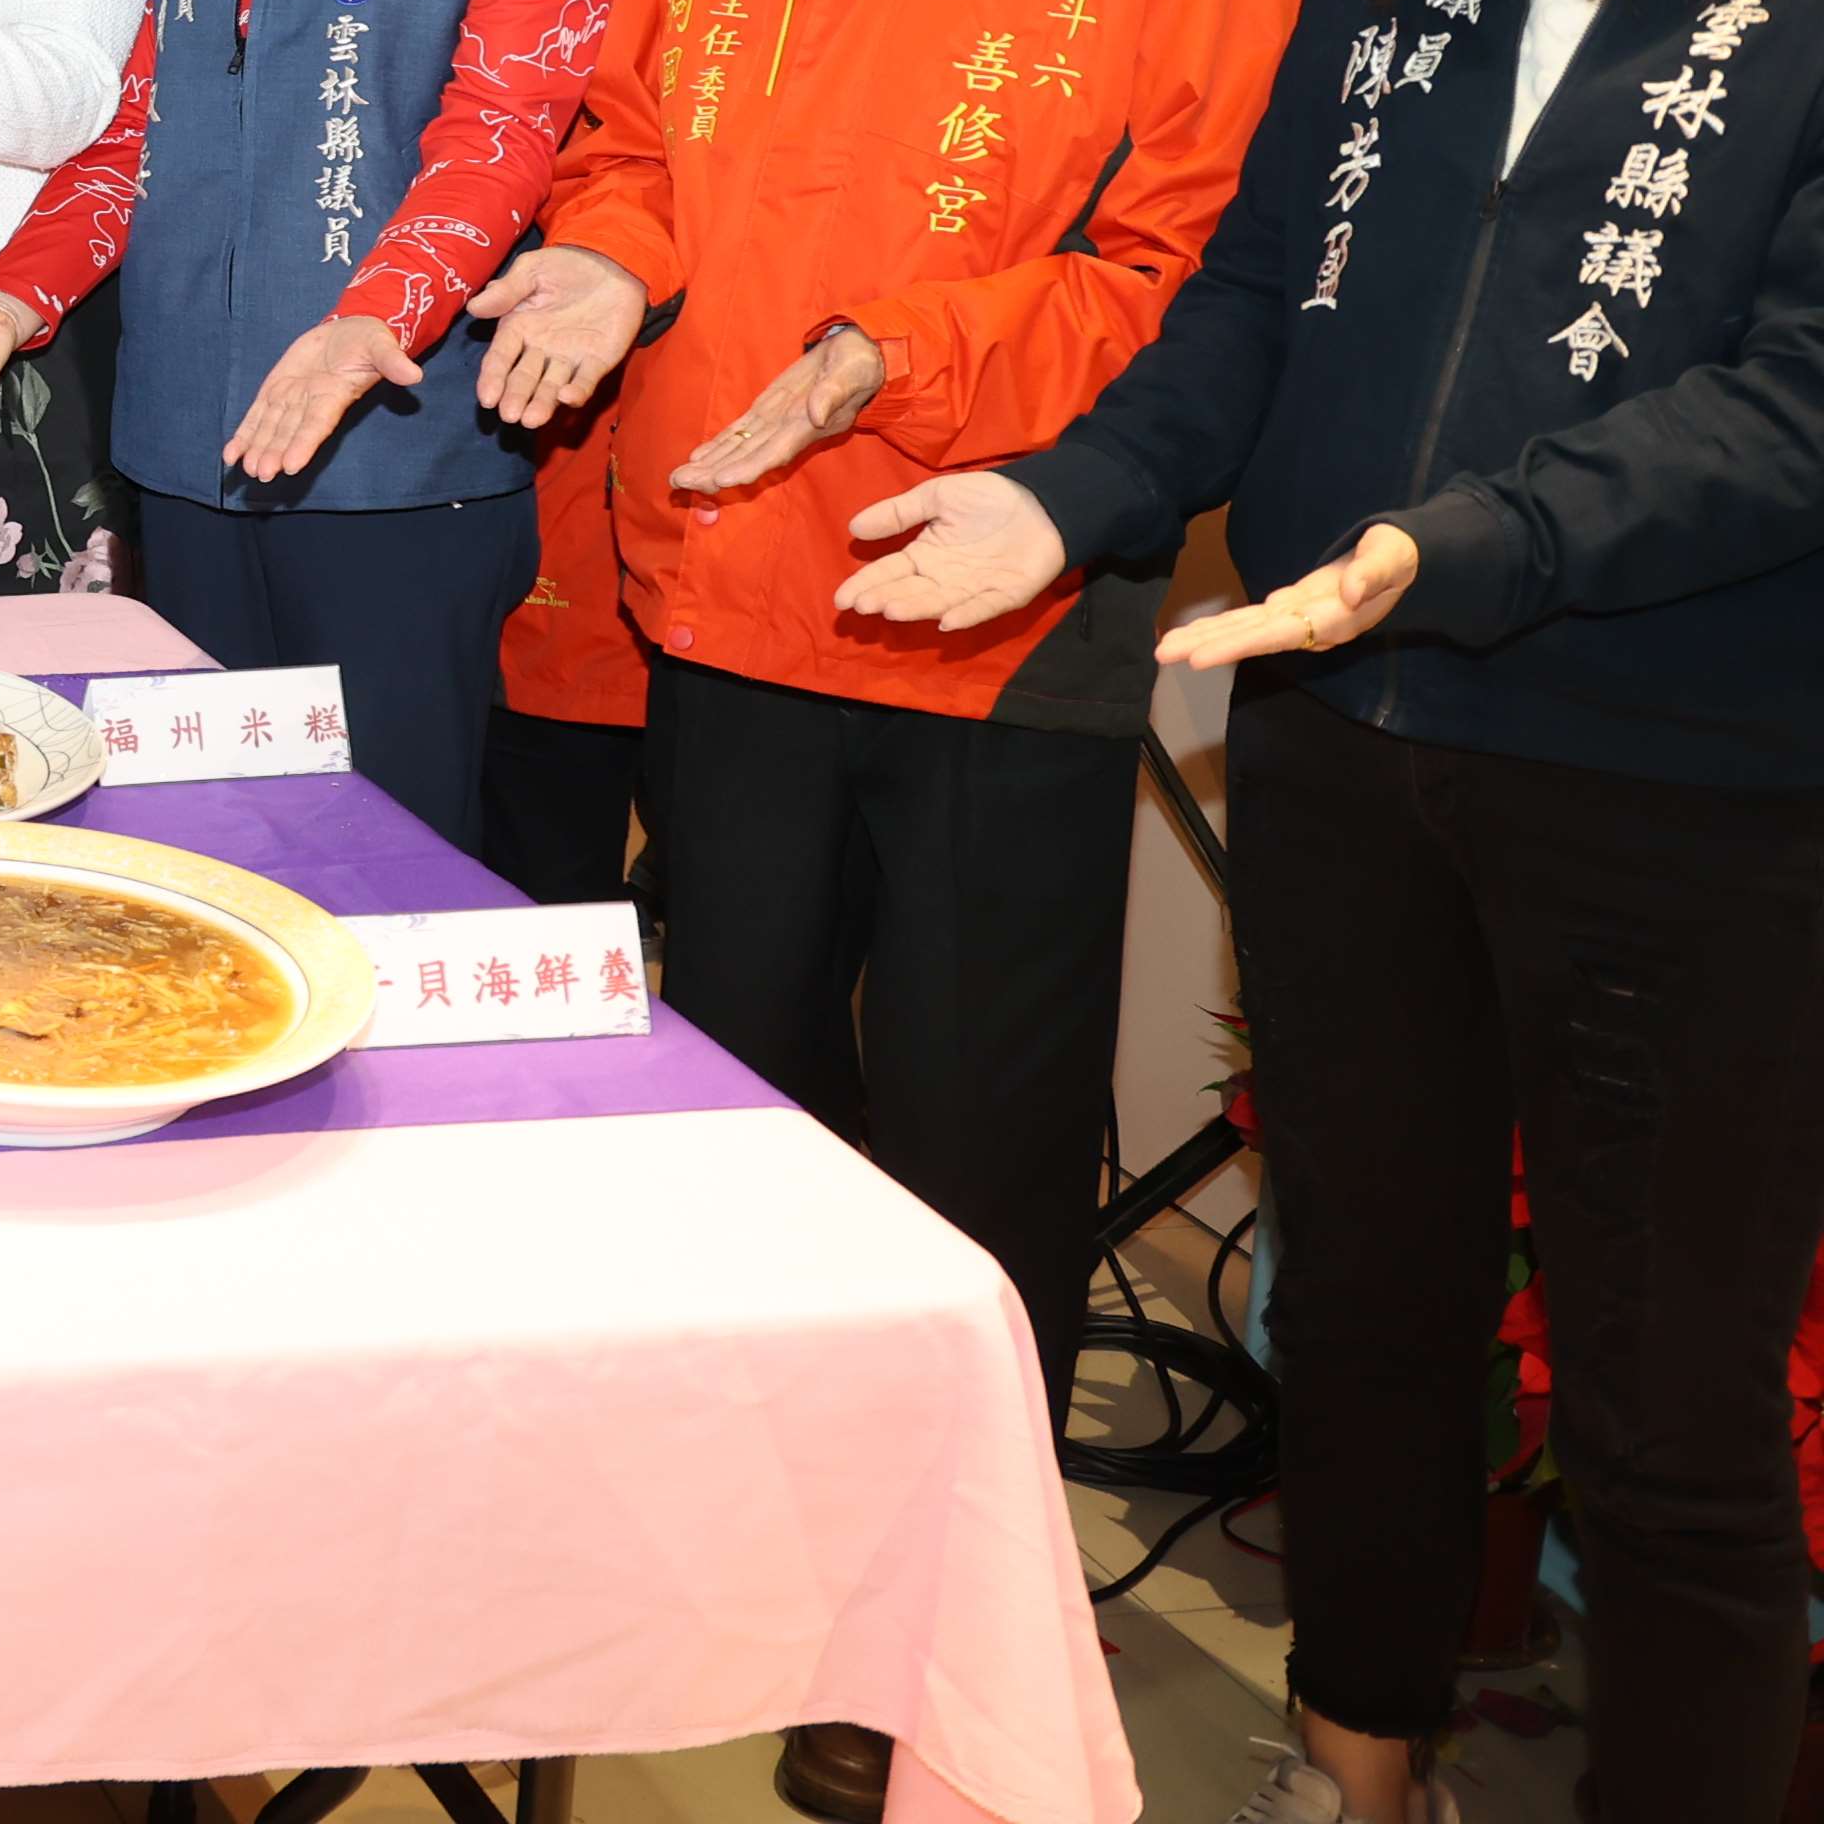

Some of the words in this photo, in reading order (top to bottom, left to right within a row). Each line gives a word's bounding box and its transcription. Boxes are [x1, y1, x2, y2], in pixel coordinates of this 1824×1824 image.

[314, 14, 370, 267] 雲林縣議員
[924, 30, 1019, 234] 善修宮
[99, 703, 349, 755] 福州米糕
